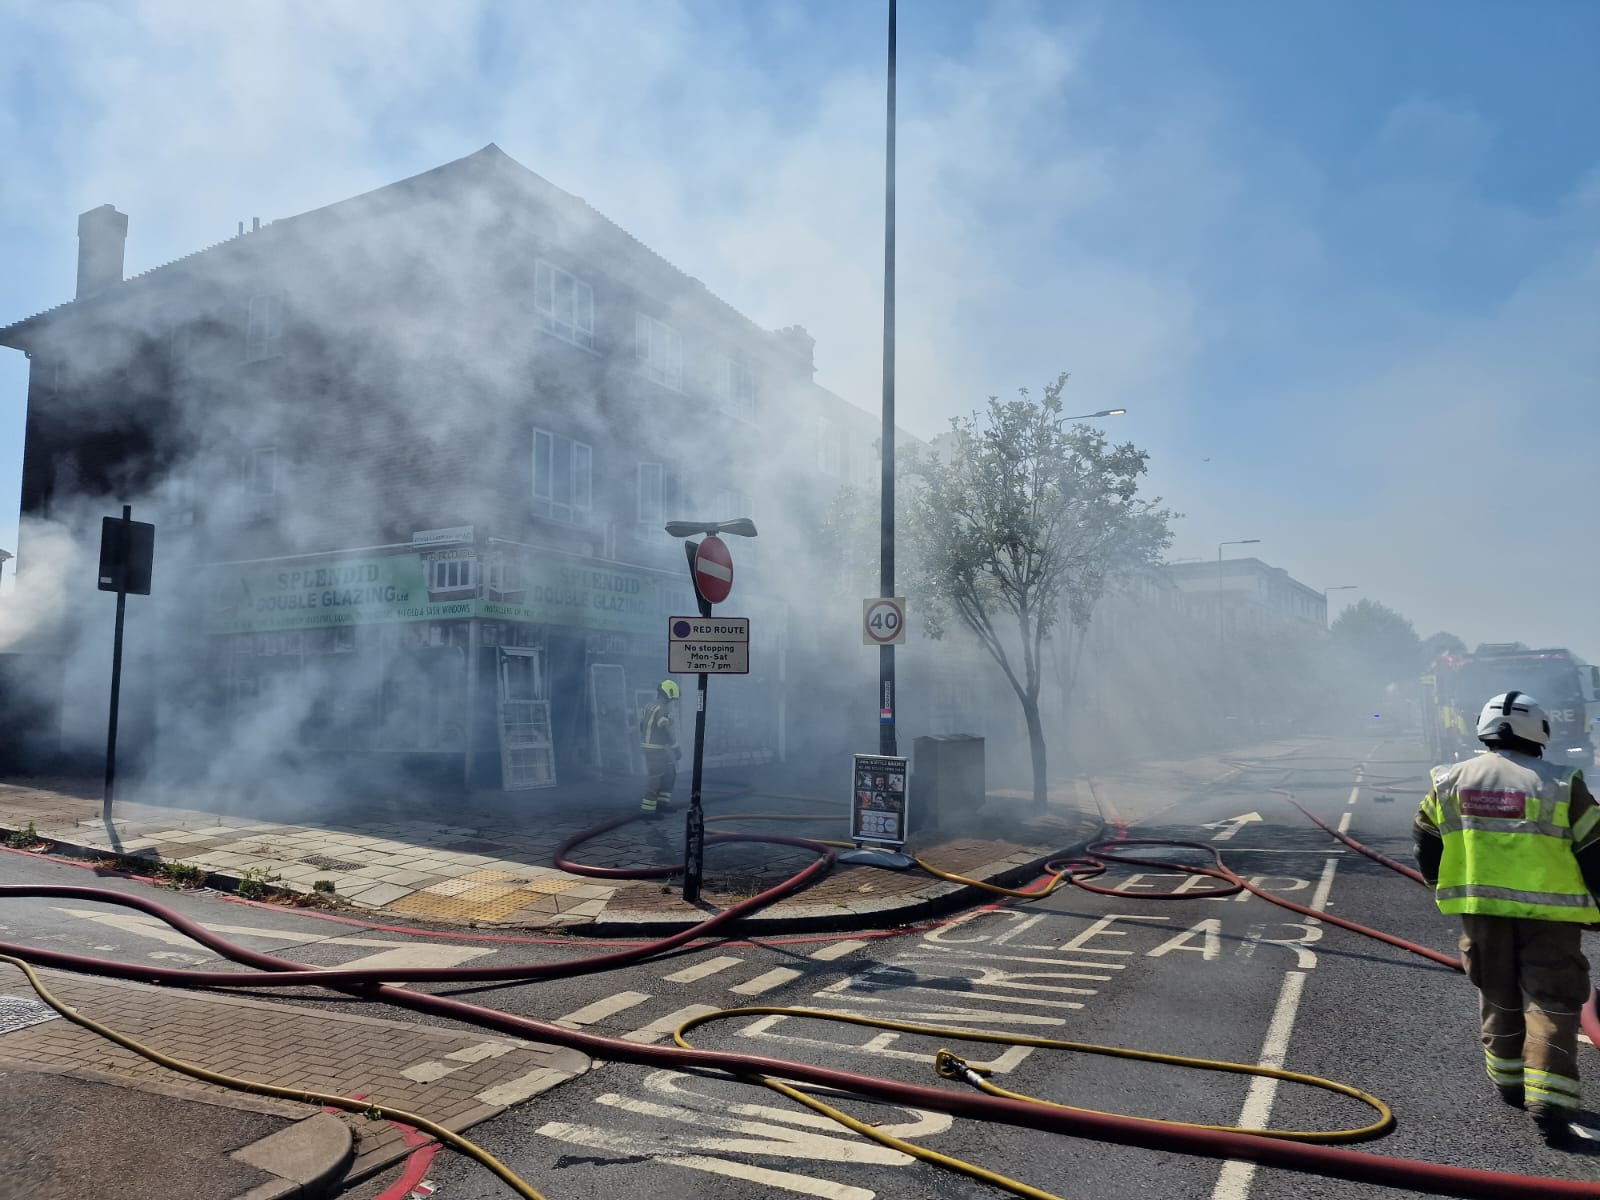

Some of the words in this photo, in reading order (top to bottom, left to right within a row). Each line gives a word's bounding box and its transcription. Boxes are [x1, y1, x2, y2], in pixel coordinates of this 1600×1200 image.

[277, 564, 380, 590] SPLENDID
[560, 567, 641, 595] SPLENDID
[255, 594, 317, 613] DOUBLE
[321, 585, 396, 608] GLAZING
[535, 585, 589, 607] DOUBLE
[693, 626, 712, 634] RED
[714, 626, 745, 634] ROUTE
[870, 612, 898, 630] 40
[699, 645, 735, 653] stopping
[1550, 709, 1577, 722] RE
[1070, 872, 1311, 901] EEP
[923, 909, 1323, 969] CLEAR
